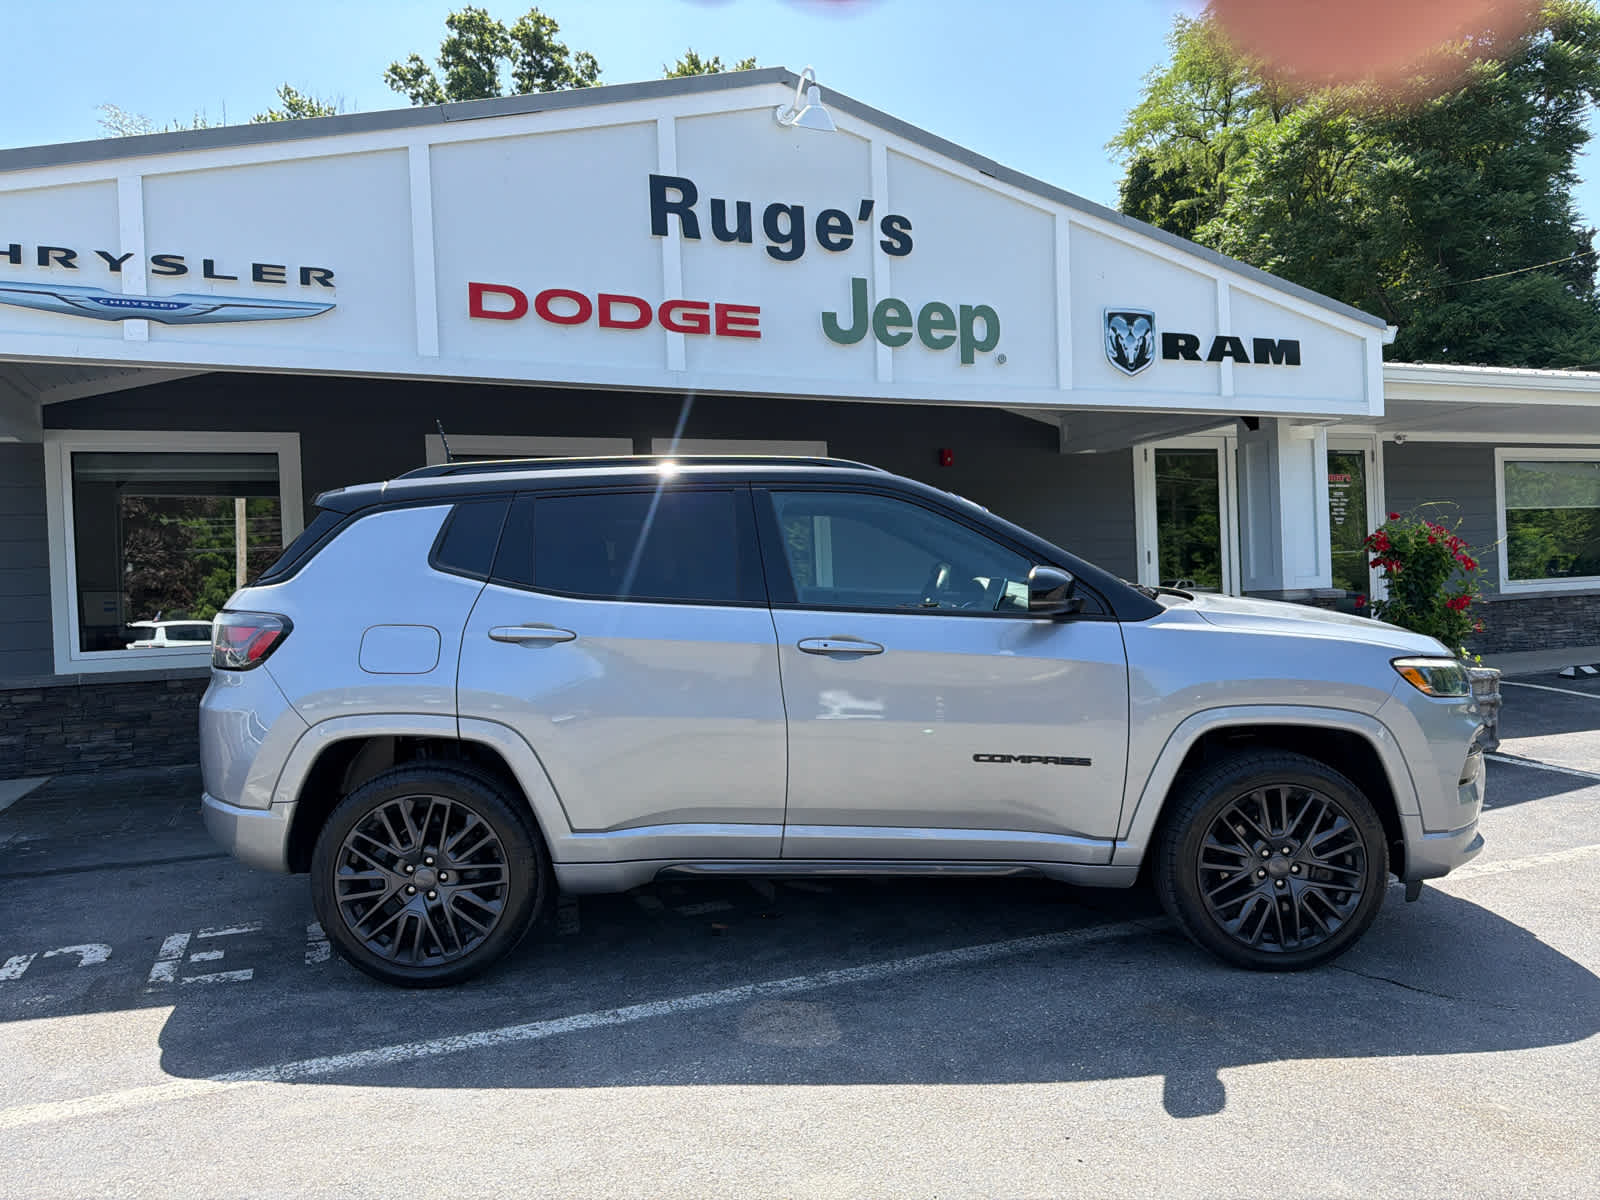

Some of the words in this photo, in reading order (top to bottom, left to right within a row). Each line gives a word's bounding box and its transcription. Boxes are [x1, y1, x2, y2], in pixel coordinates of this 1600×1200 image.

[98, 299, 179, 309] CHRYSLER
[469, 282, 761, 338] DODGE
[822, 277, 1000, 365] Jeep
[1162, 332, 1301, 366] RAM
[972, 753, 1092, 767] COMPASS
